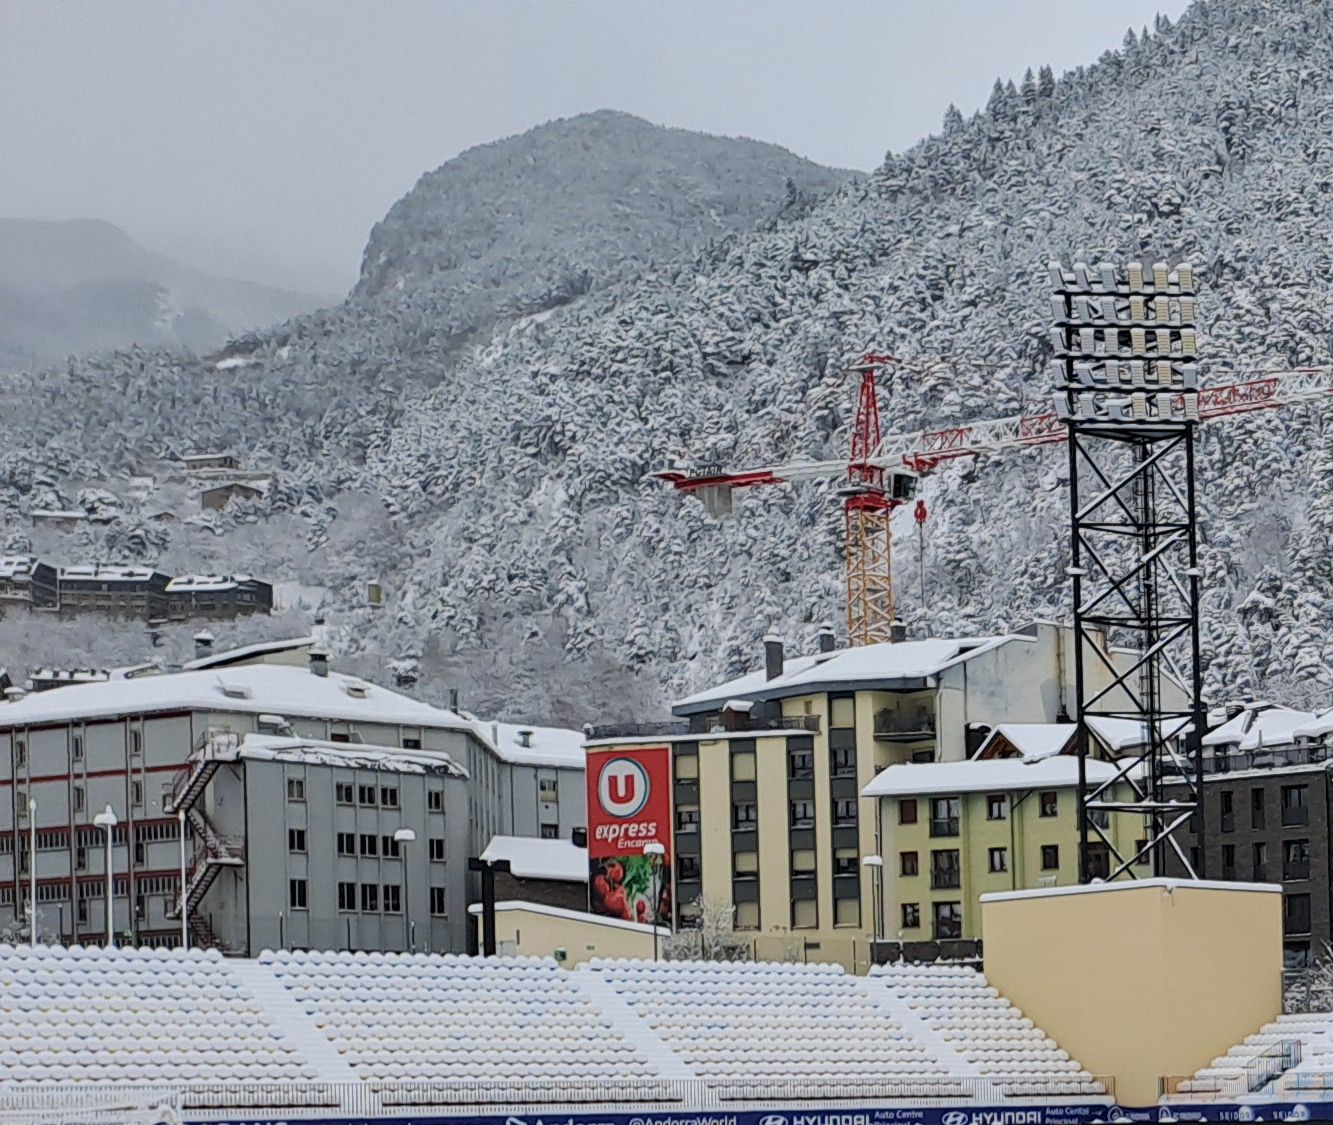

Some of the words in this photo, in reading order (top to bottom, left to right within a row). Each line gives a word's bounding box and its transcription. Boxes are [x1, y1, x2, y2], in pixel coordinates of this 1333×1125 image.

[608, 774, 635, 805] U
[595, 821, 657, 843] express
[972, 1111, 1041, 1125] HYUNDAI
